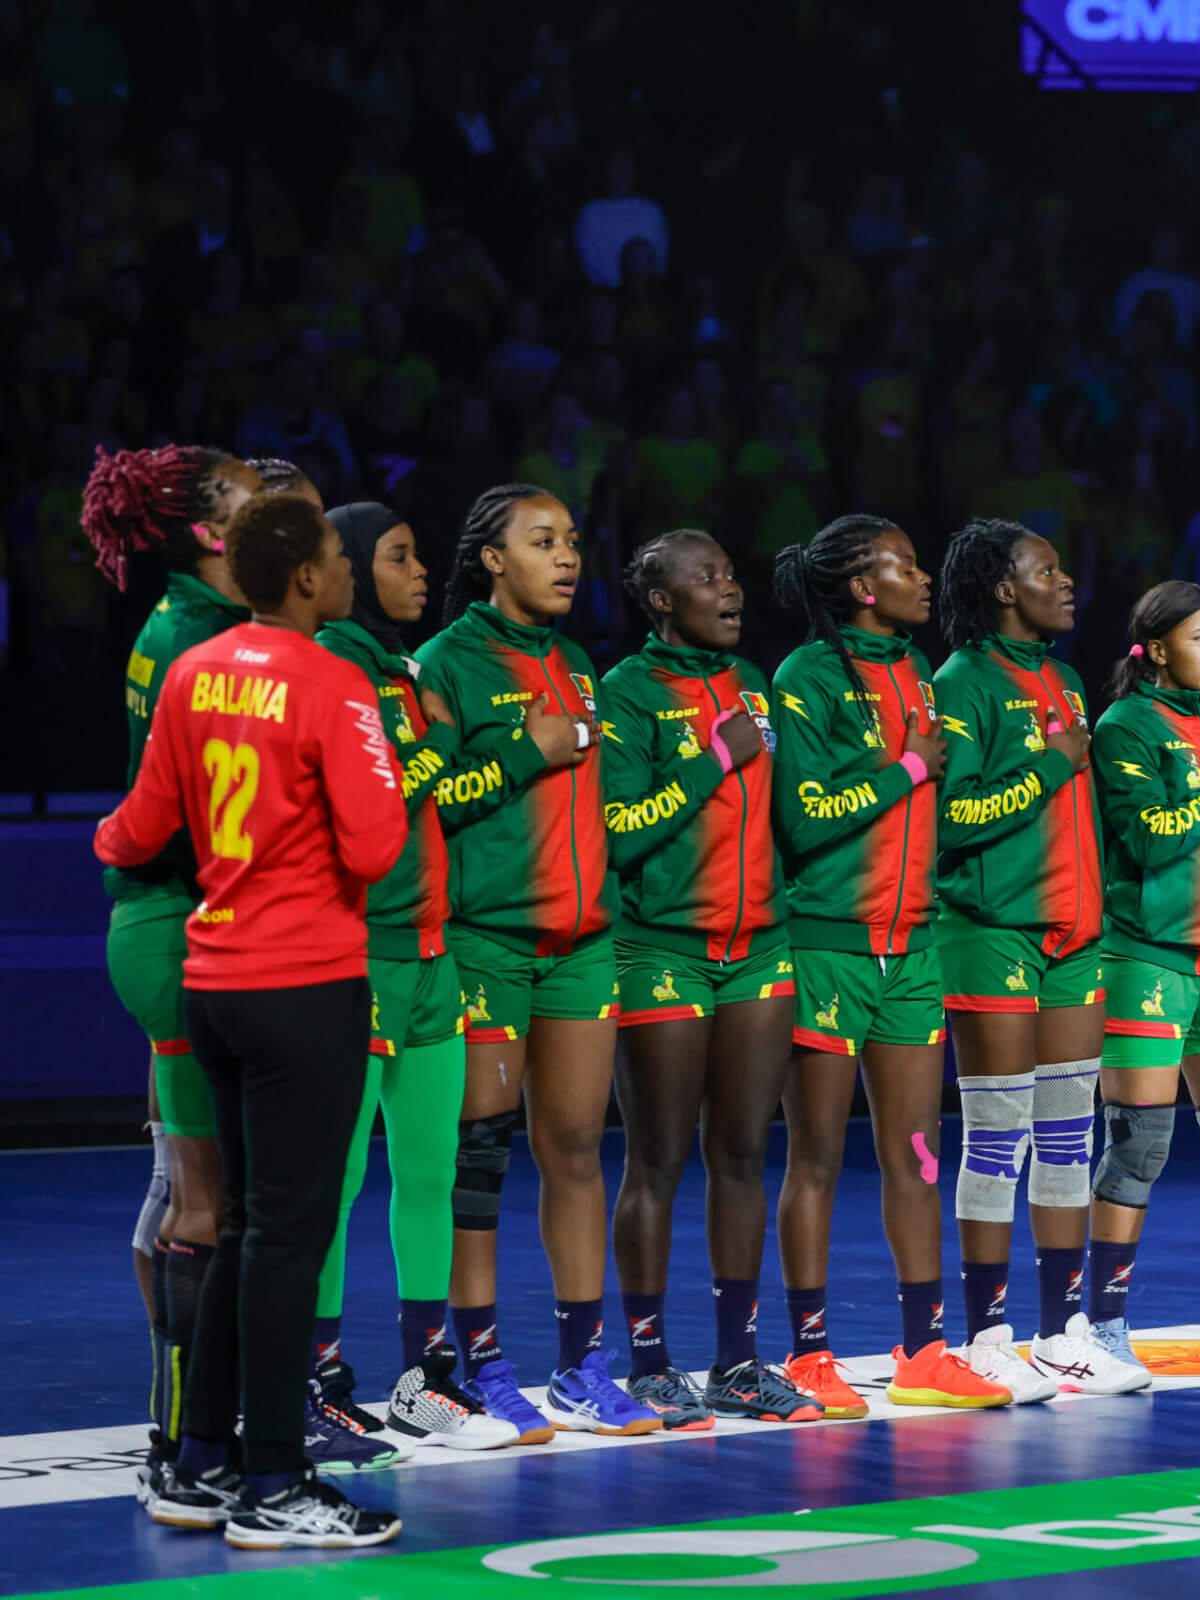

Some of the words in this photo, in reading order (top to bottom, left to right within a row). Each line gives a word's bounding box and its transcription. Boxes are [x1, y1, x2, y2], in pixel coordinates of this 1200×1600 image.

[191, 671, 289, 724] BALANA
[203, 738, 260, 861] 22
[632, 1336, 662, 1347] Zeus
